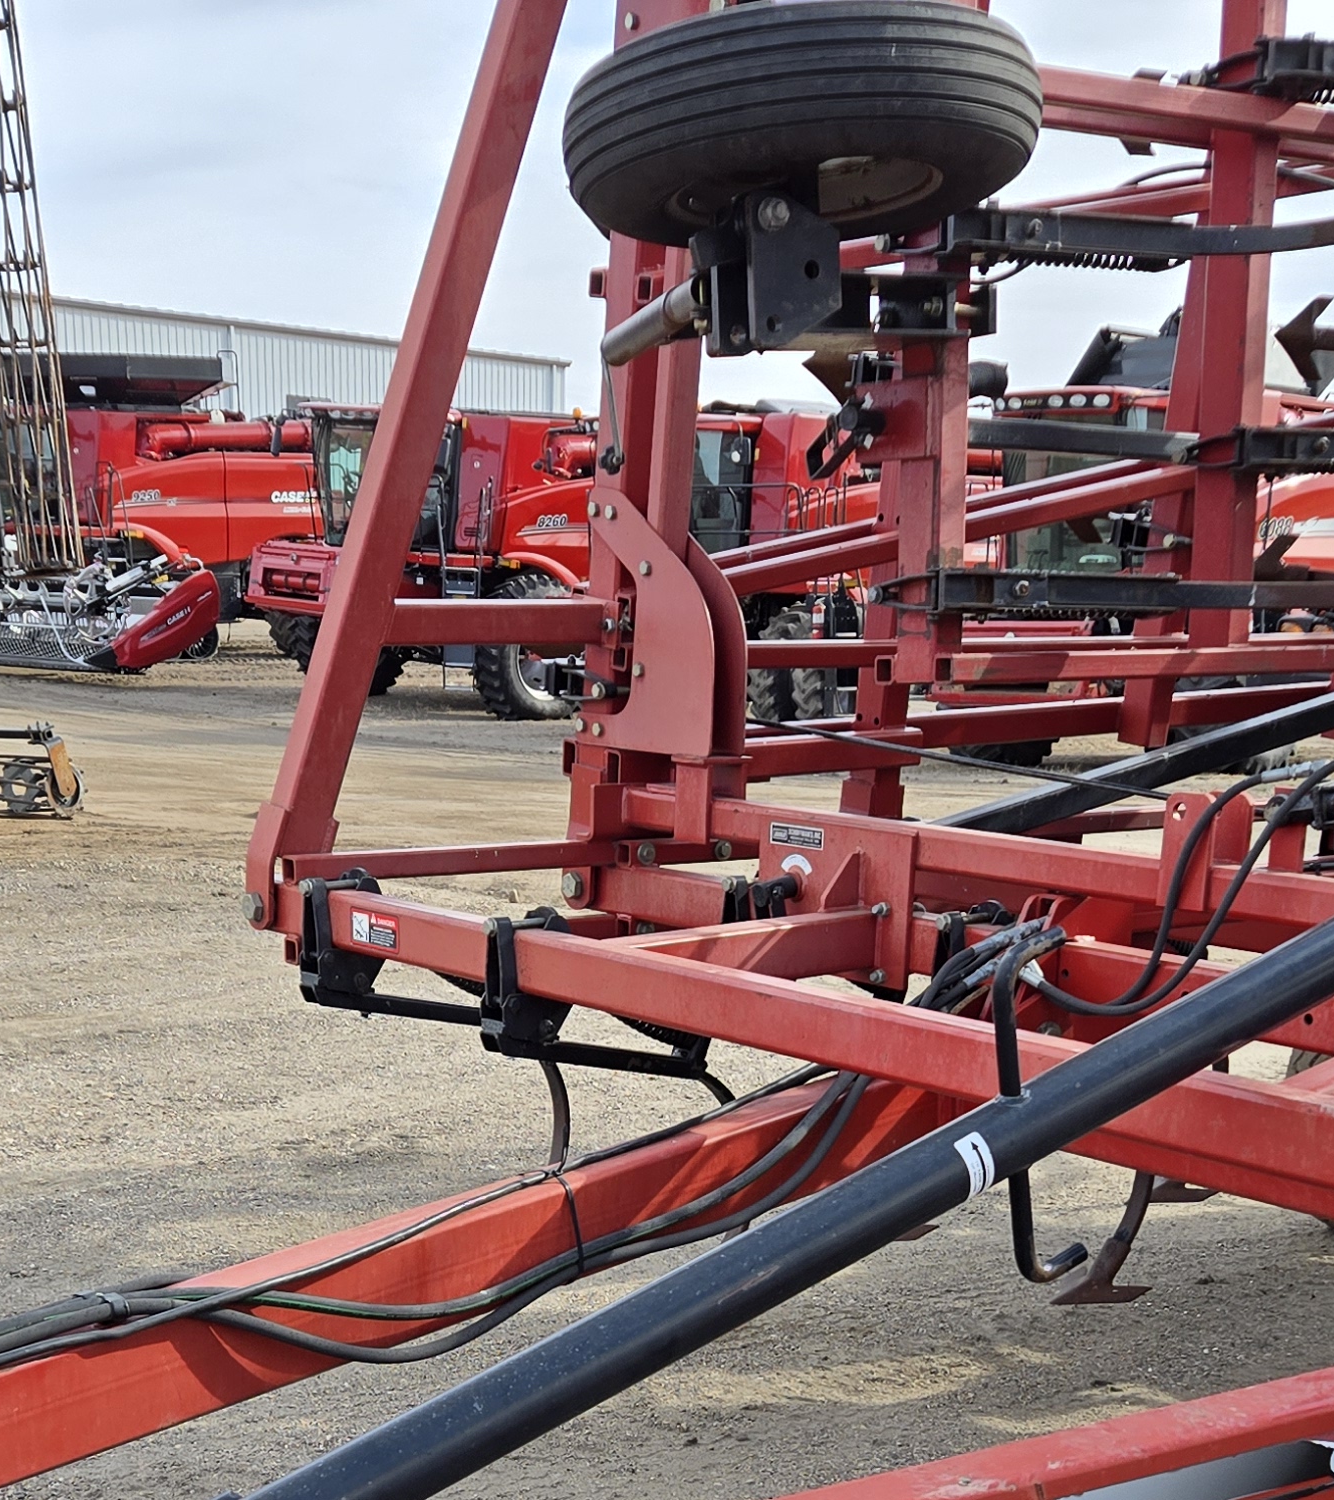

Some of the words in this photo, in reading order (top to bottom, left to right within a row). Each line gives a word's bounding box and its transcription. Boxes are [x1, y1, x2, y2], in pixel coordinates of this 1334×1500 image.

[132, 490, 161, 502] 9250
[271, 490, 305, 503] CASE
[537, 514, 568, 528] 8260
